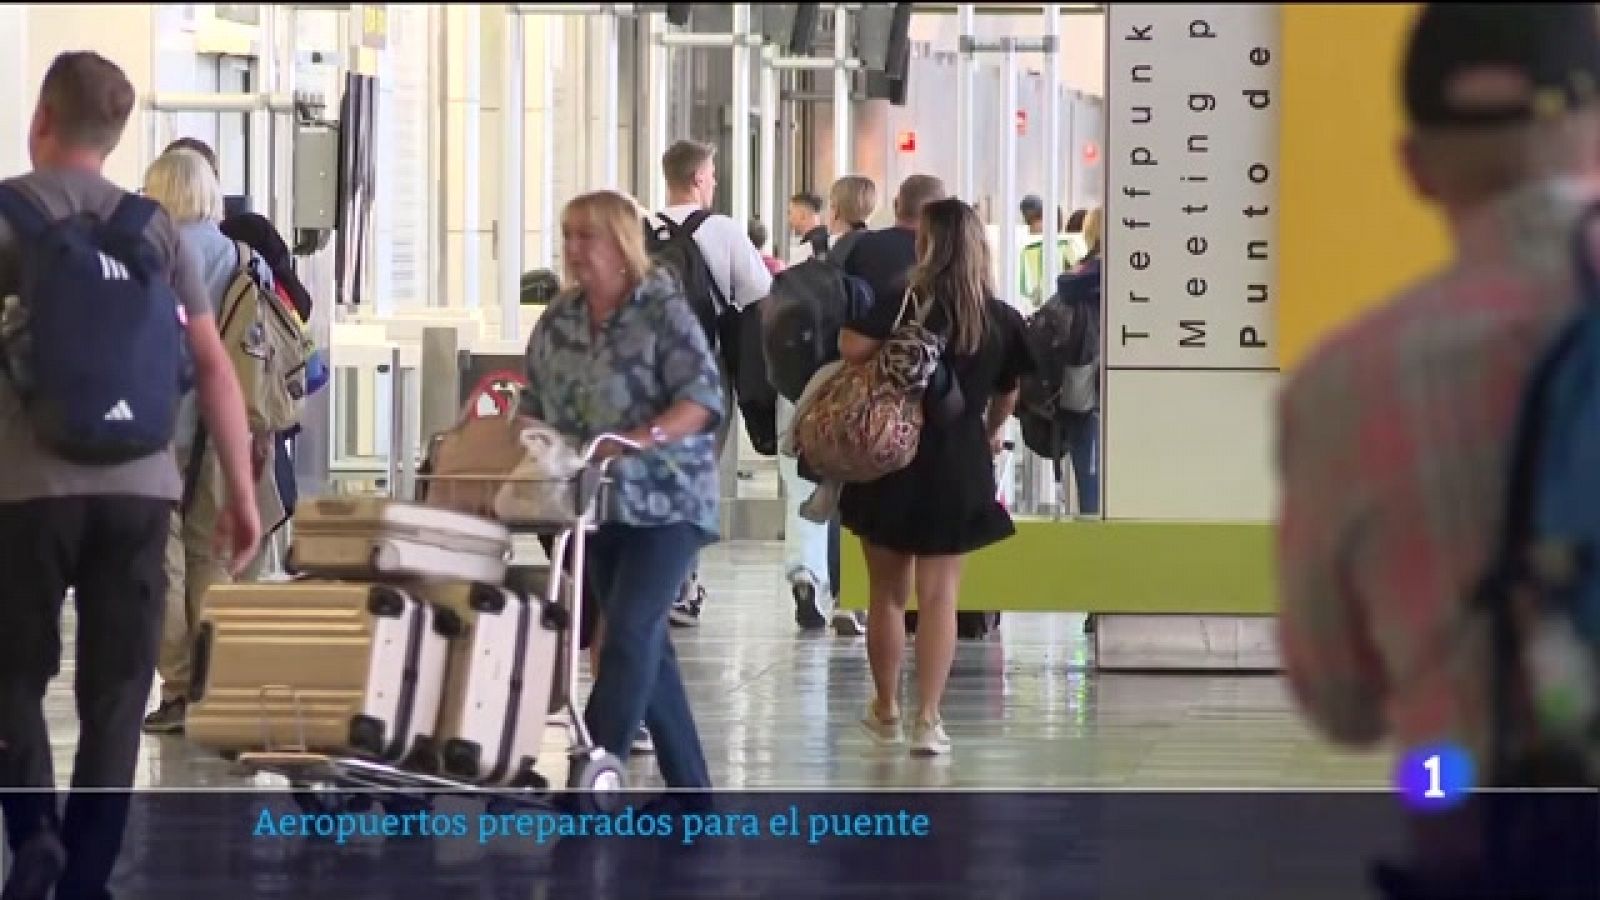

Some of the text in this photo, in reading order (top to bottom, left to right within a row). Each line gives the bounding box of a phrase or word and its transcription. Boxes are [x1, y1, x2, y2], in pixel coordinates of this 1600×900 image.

[1122, 24, 1158, 346] Treffpunk
[1179, 19, 1217, 348] Meeting p
[1239, 46, 1271, 348] Punto de
